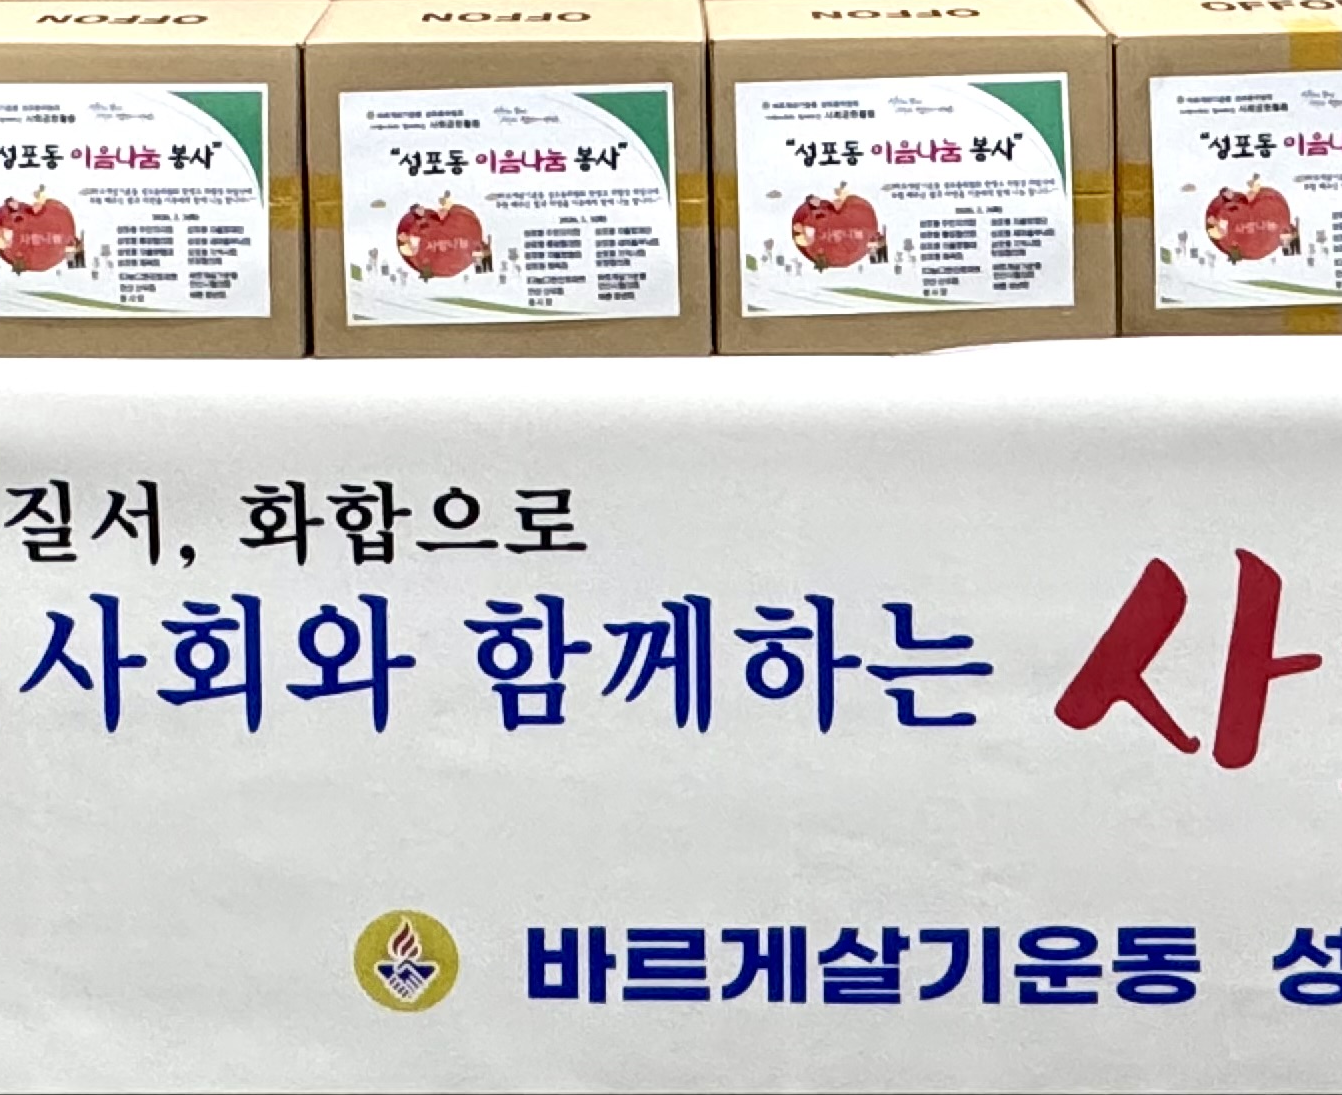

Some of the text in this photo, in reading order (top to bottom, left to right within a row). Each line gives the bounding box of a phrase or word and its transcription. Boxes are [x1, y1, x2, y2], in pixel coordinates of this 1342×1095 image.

[36, 14, 210, 26] OFFON
[421, 12, 592, 24] OFFON
[811, 9, 983, 21] OFFON
[71, 146, 161, 170] 이음나눔
[476, 149, 566, 174] 이음나눔
[871, 138, 962, 164] 이음나눔
[3, 479, 198, 568] 질서,
[239, 479, 589, 567] 화합으로
[463, 594, 995, 735] 함께하는
[527, 926, 1203, 1006] 바르게살기운동
